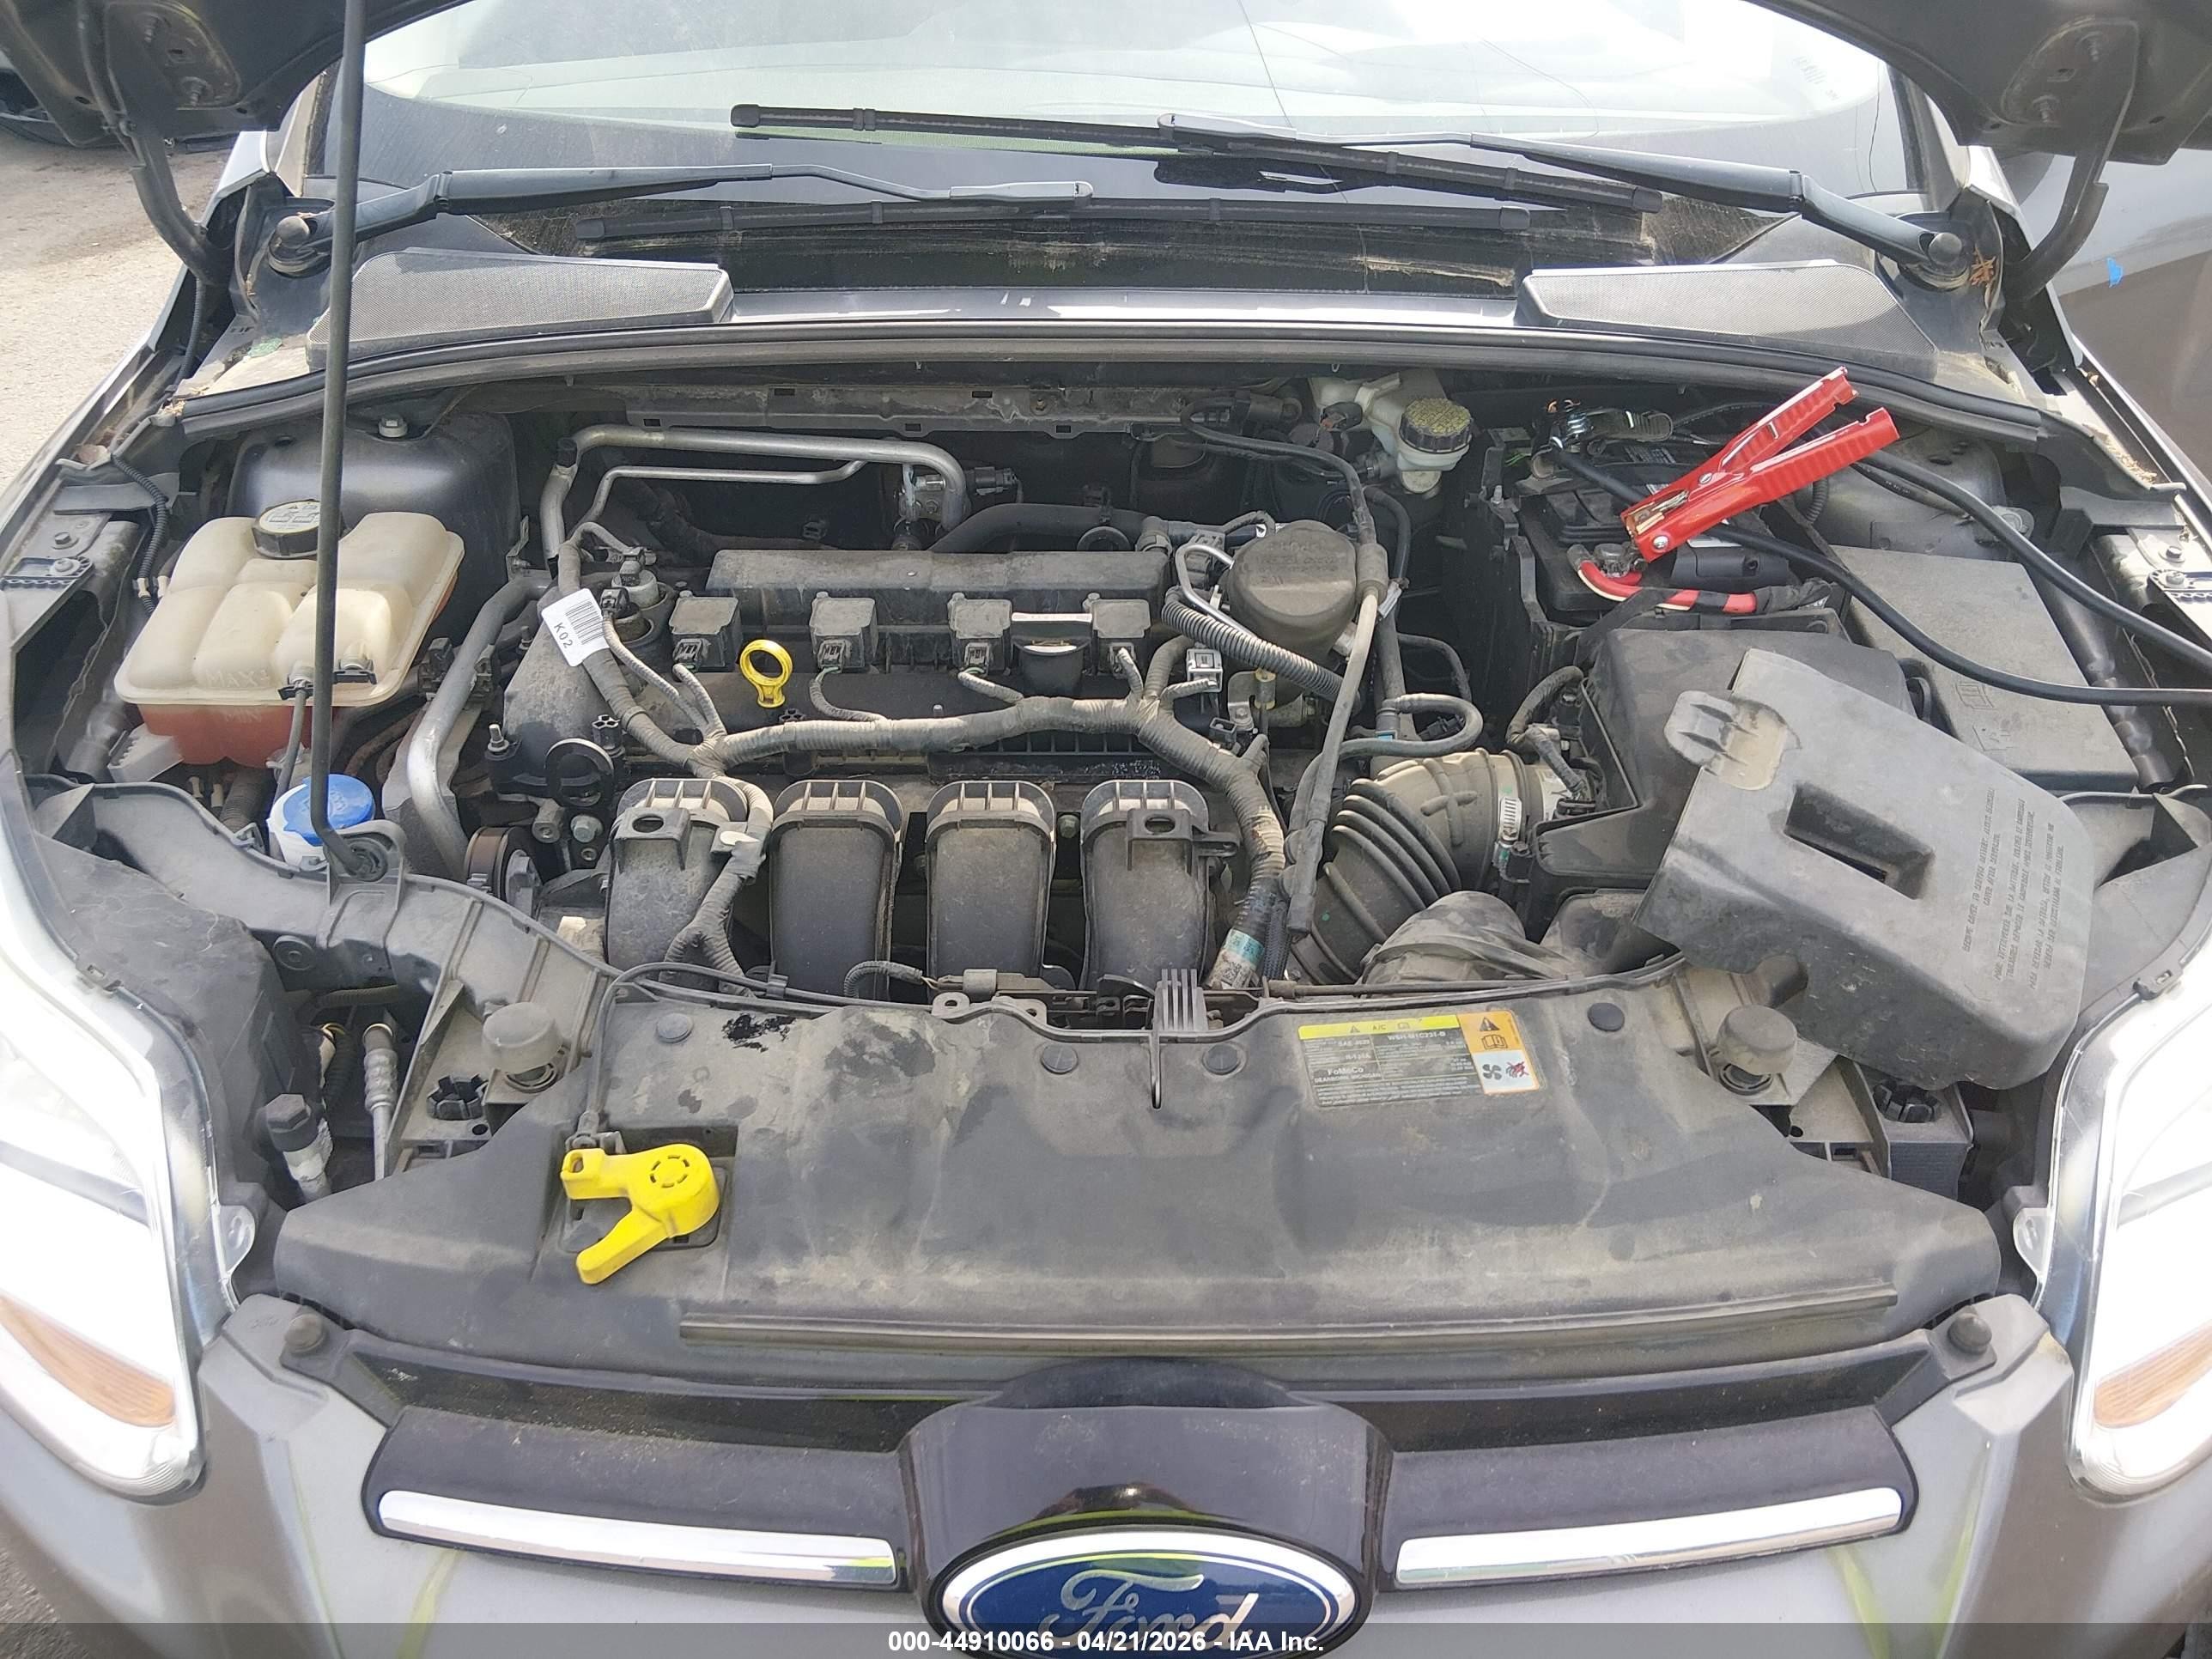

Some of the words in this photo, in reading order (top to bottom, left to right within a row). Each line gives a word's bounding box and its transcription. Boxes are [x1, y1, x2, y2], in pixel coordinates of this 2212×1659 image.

[554, 622, 574, 649] K02
[205, 669, 258, 688] MAX
[1038, 1570, 1260, 1650] Ford
